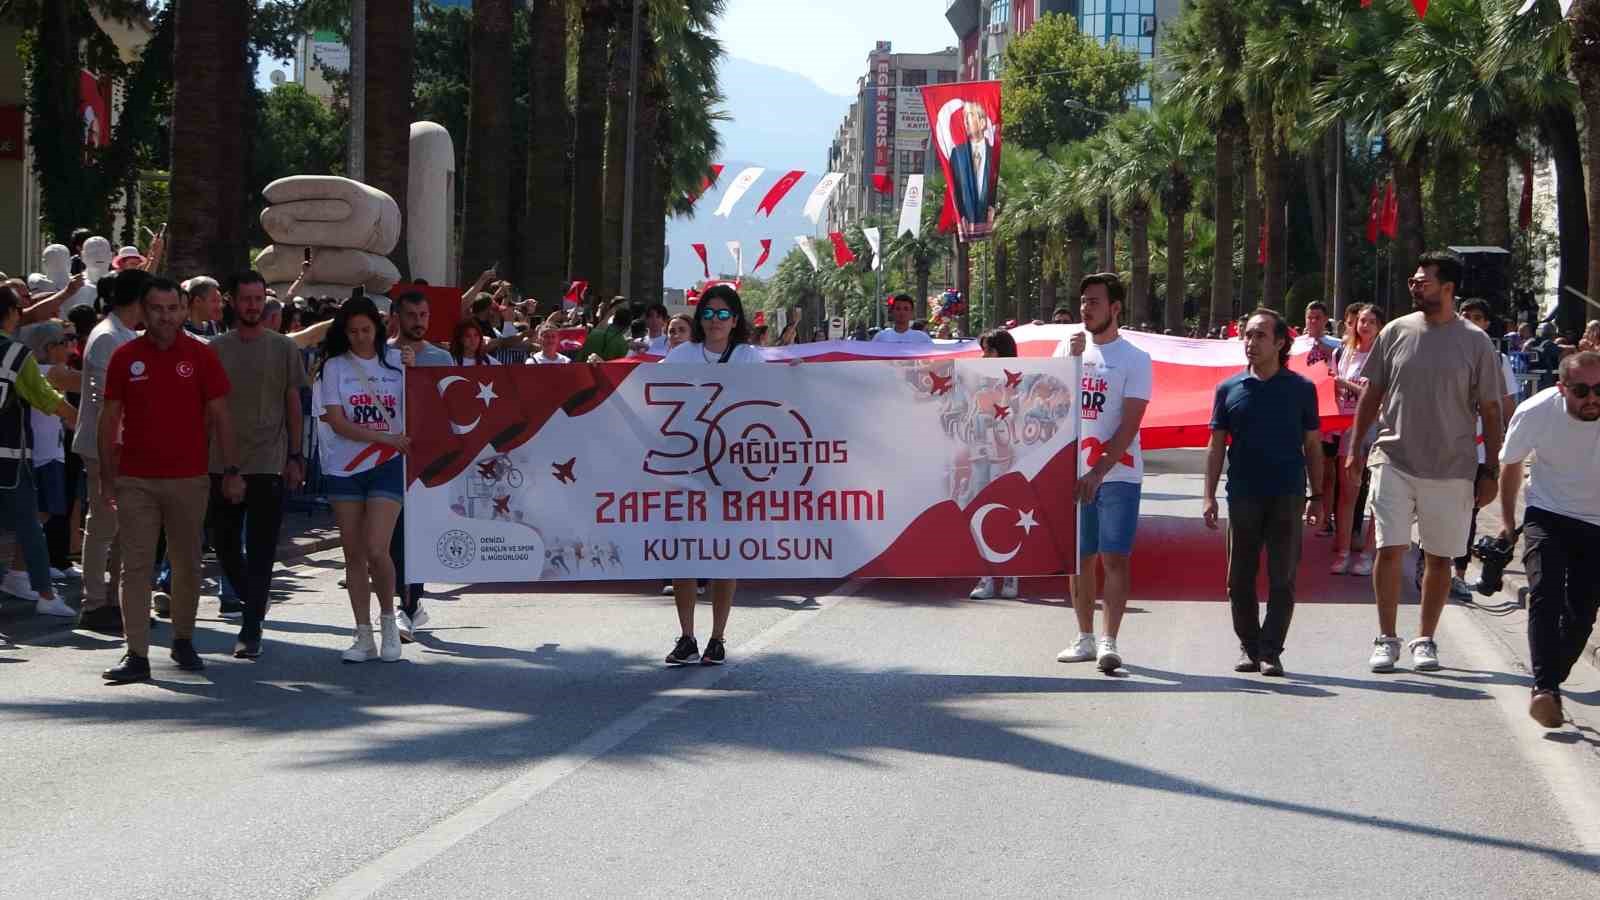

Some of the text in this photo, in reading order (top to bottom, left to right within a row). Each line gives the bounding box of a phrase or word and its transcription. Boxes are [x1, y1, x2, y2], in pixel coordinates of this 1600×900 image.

[877, 63, 889, 97] EGE
[876, 101, 889, 148] KURS
[1082, 391, 1105, 412] OR
[643, 382, 848, 486] 30 AĞUSTOS
[596, 489, 884, 523] ZAFER BAYRAMI
[644, 538, 832, 561] KUTLU OLSUN
